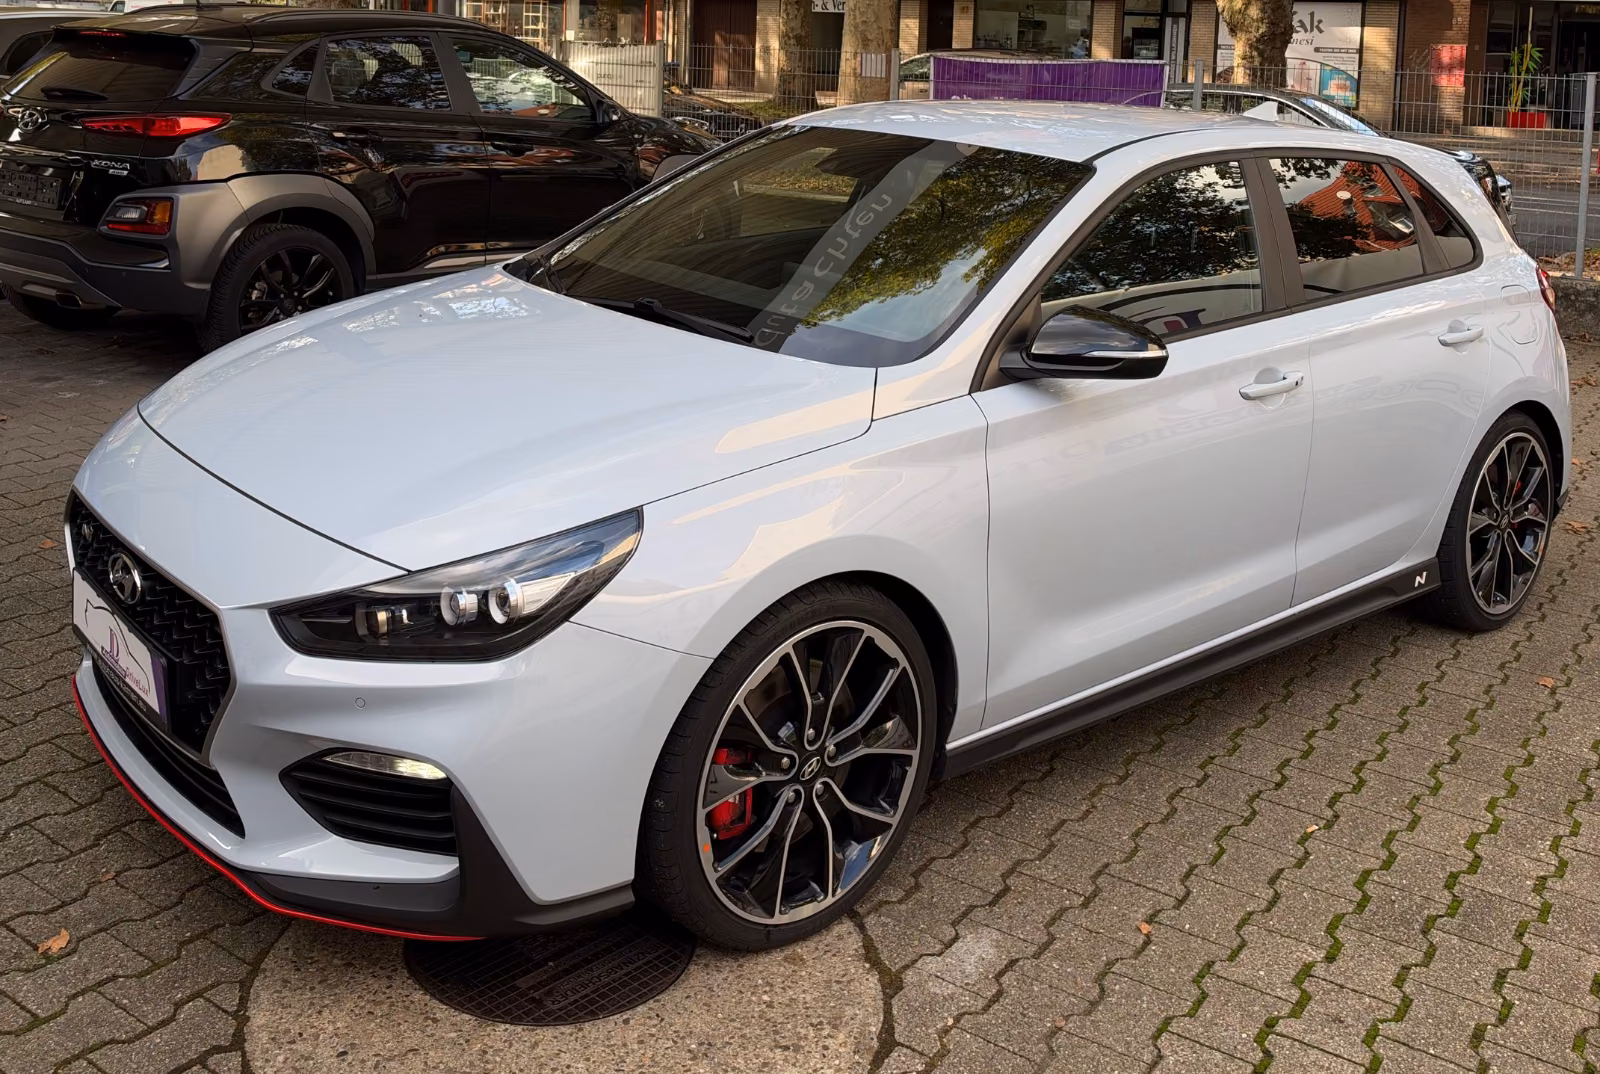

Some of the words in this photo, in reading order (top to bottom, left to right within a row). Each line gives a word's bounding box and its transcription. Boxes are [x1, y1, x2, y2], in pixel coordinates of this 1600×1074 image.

[1293, 11, 1324, 34] ak
[1291, 36, 1315, 46] nesi
[1414, 571, 1427, 588] N
